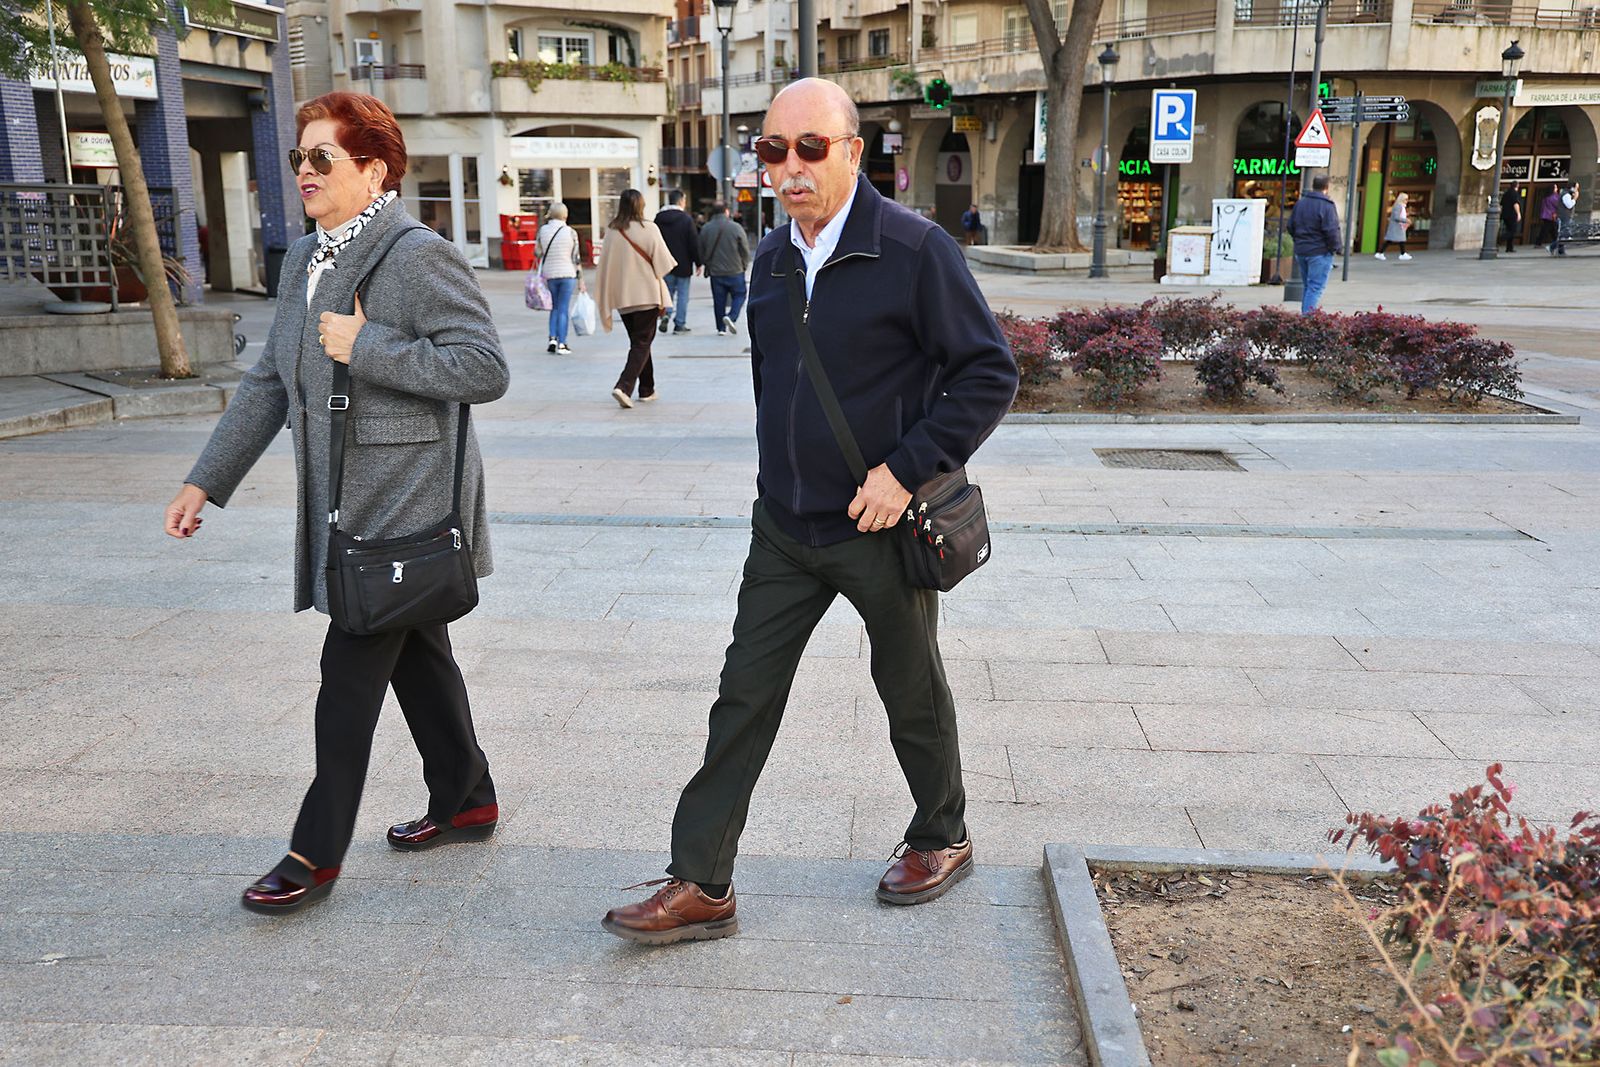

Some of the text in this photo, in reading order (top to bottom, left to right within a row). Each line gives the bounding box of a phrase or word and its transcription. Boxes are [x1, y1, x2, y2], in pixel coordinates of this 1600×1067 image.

[37, 61, 131, 81] MONTATOS
[1530, 93, 1559, 102] FARMACIA
[1578, 92, 1600, 101] PALMER
[1157, 95, 1186, 136] P
[1118, 159, 1152, 175] ACIA
[1233, 158, 1300, 175] FARMAC
[1502, 162, 1528, 178] odega
